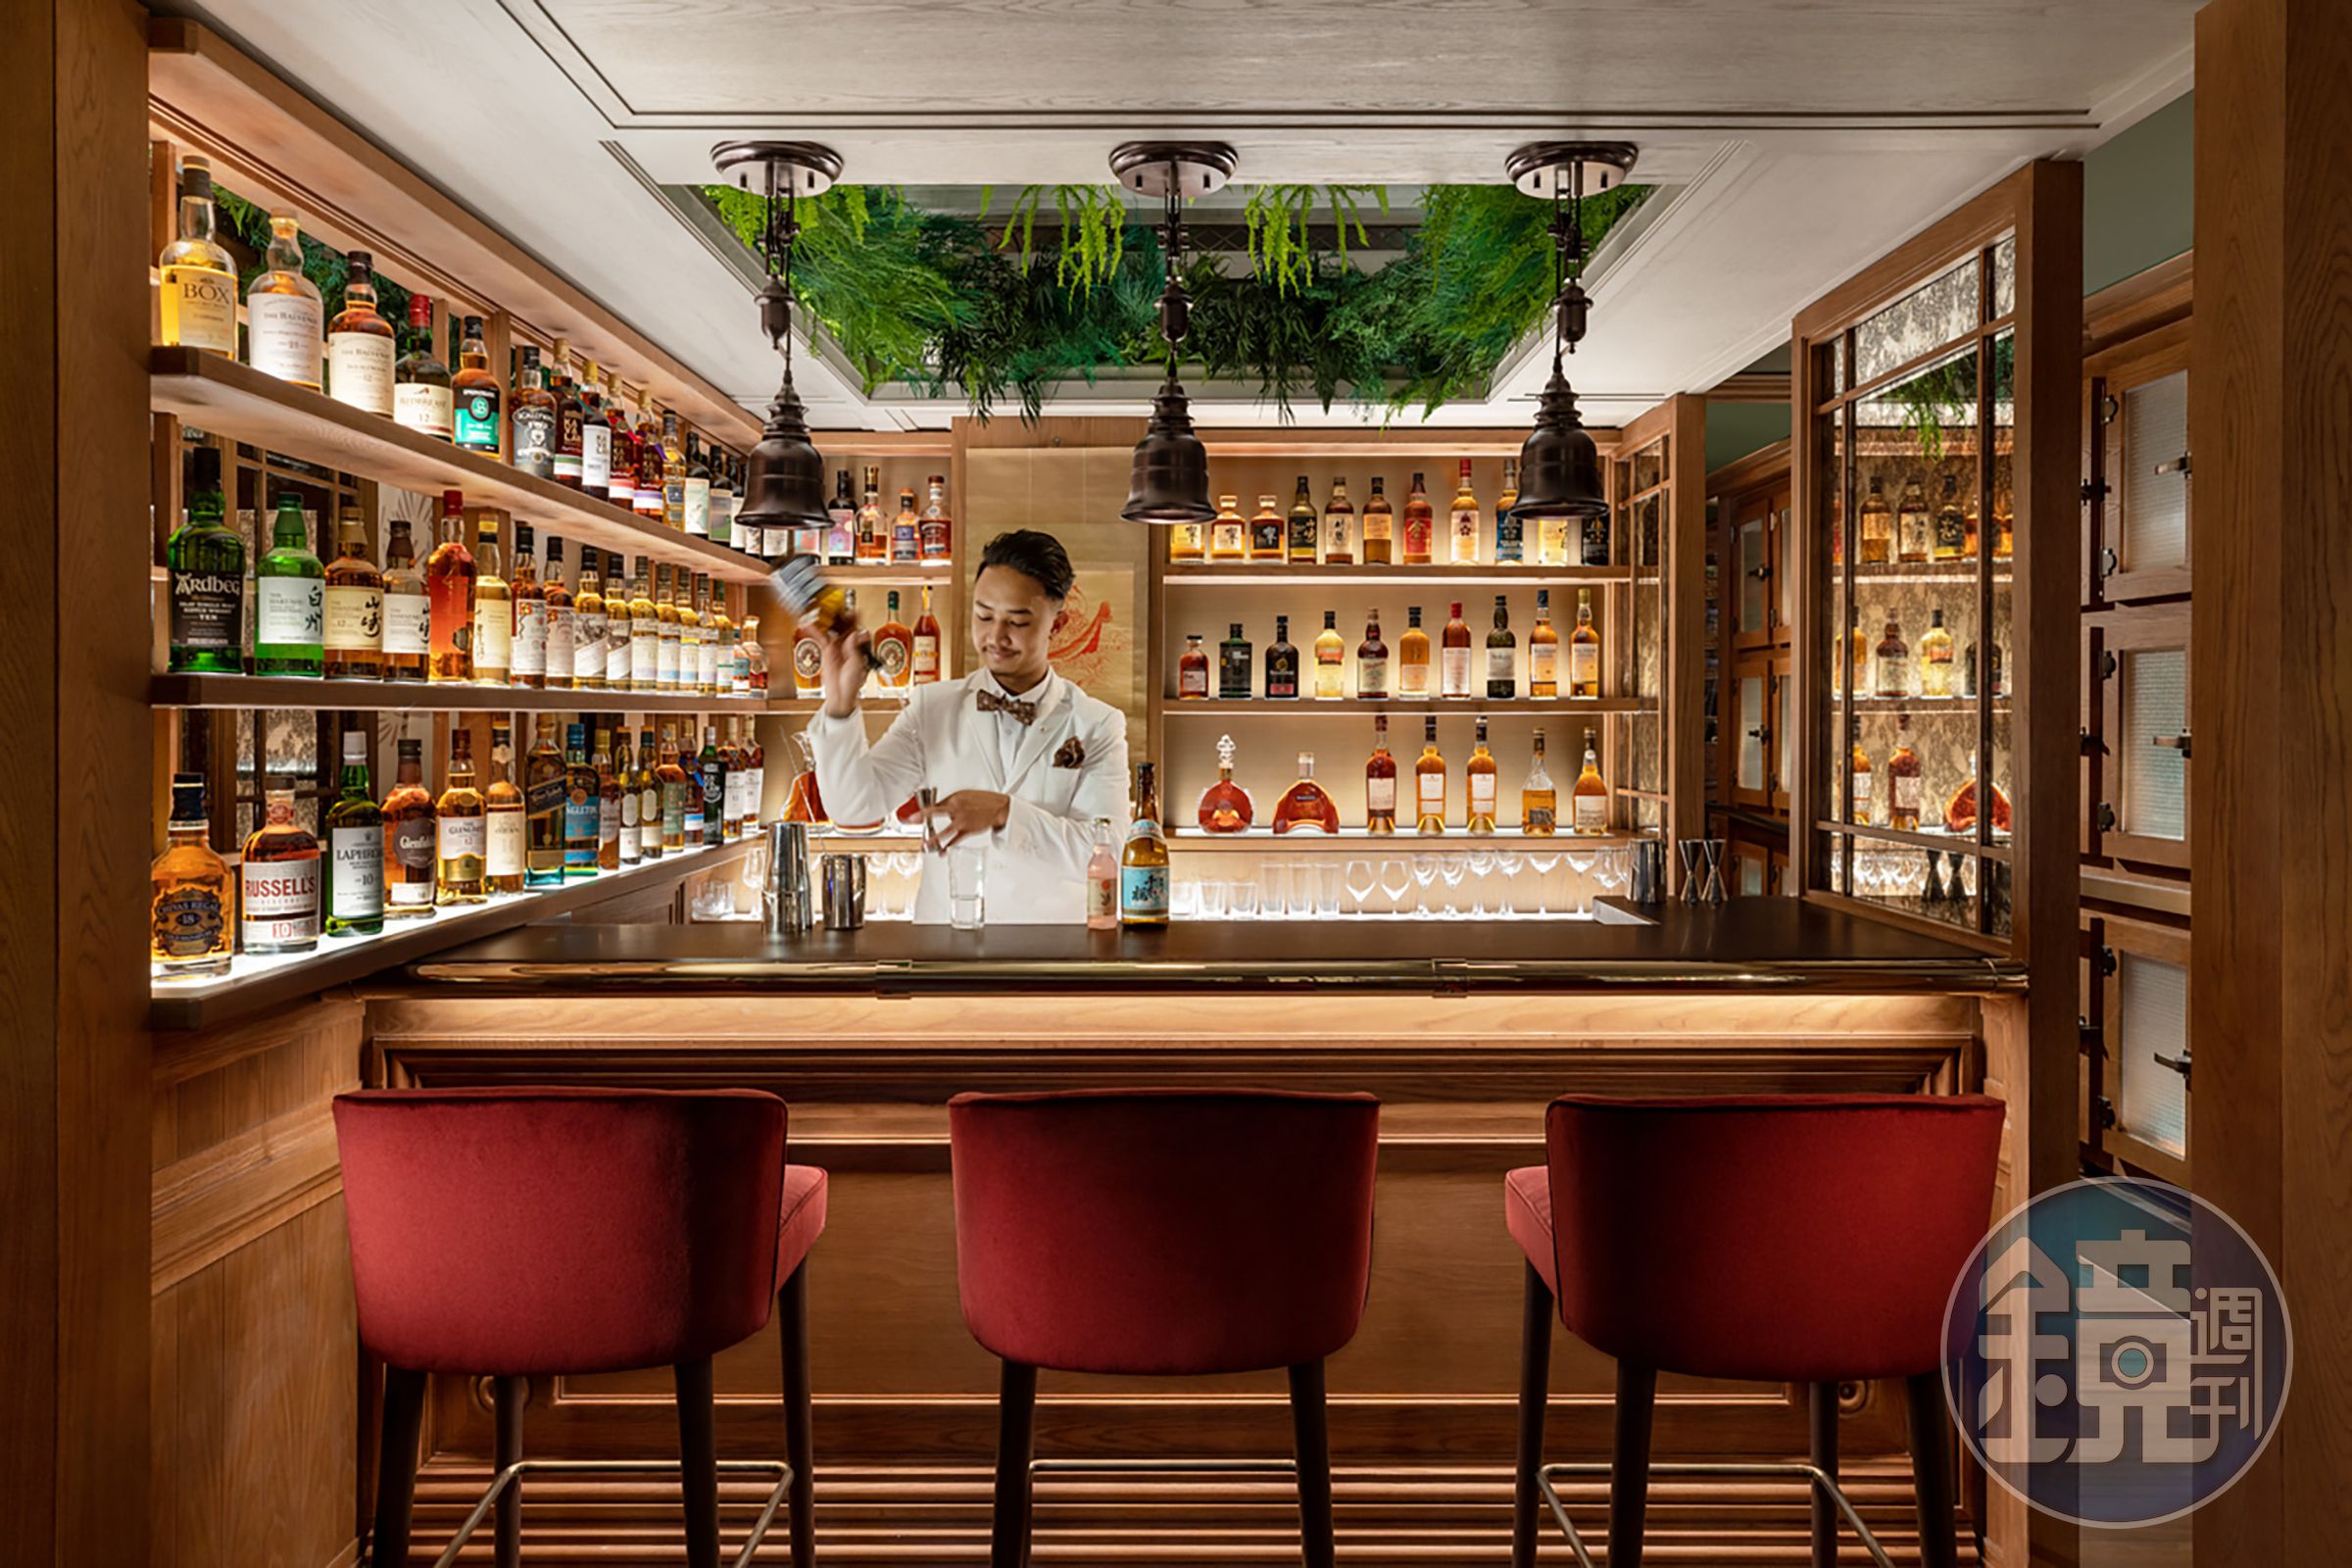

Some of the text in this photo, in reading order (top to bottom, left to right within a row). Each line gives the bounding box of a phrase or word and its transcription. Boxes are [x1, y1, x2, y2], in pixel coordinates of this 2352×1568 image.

[183, 283, 229, 305] BOX
[418, 413, 430, 422] 12
[305, 585, 324, 635] 白州
[361, 596, 381, 637] 山崎
[245, 876, 315, 898] RUSSELL'S
[363, 873, 374, 886] 10
[157, 900, 221, 915] CHIVAS REGAL
[182, 912, 195, 924] 18
[272, 922, 292, 938] 10
